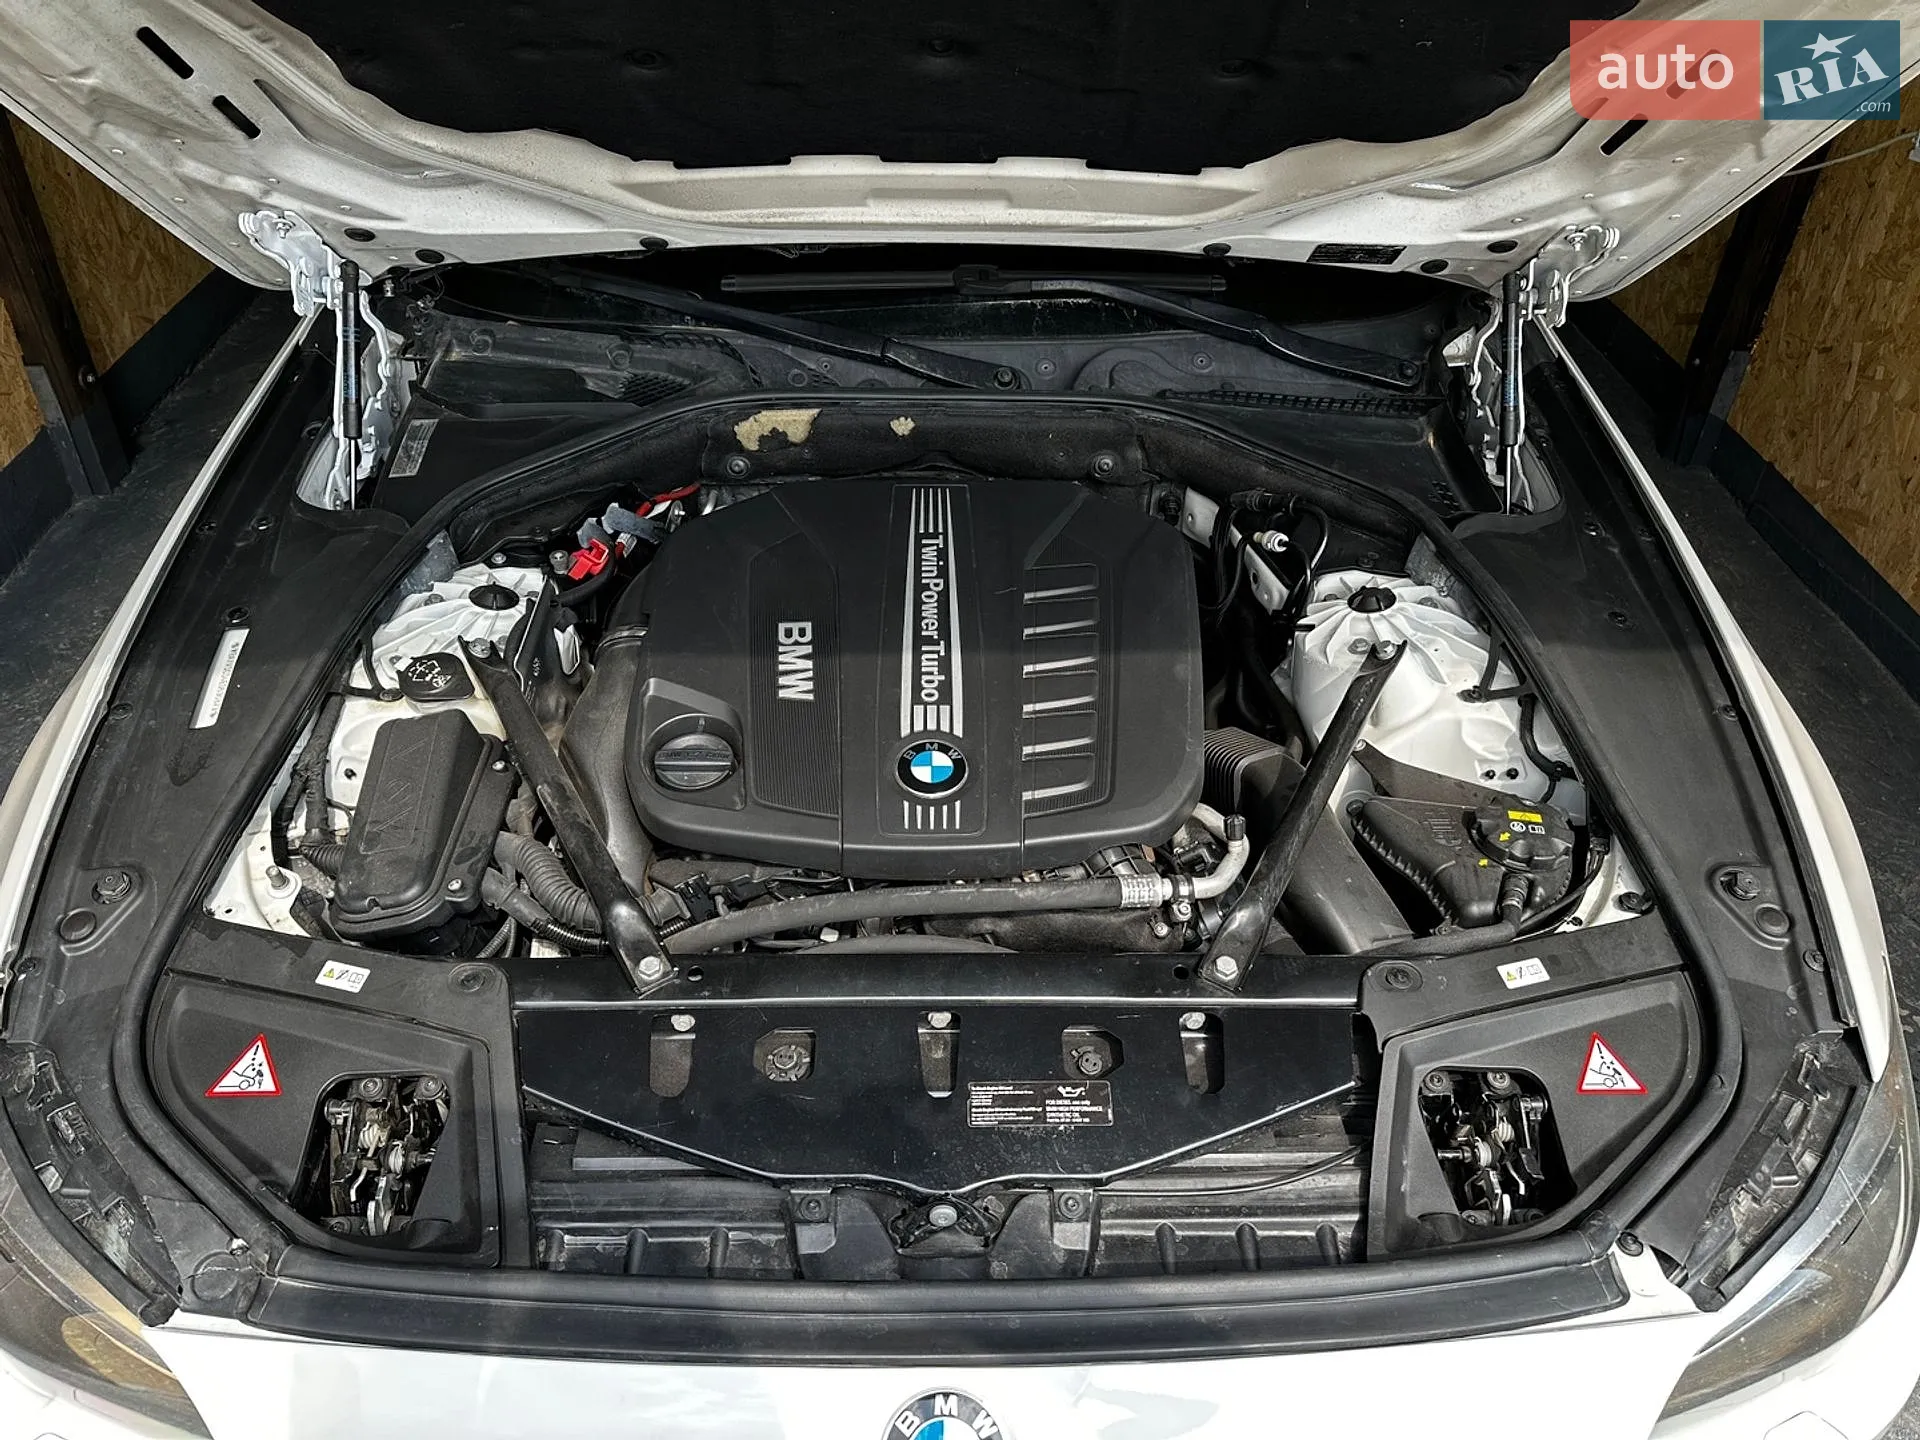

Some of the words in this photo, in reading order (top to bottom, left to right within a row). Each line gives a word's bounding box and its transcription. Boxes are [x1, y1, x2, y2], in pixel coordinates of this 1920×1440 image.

[921, 534, 944, 639] TwinPower
[778, 621, 814, 700] BMW
[921, 640, 946, 703] Turbo
[903, 742, 962, 760] BMW
[894, 1393, 999, 1440] BMW
